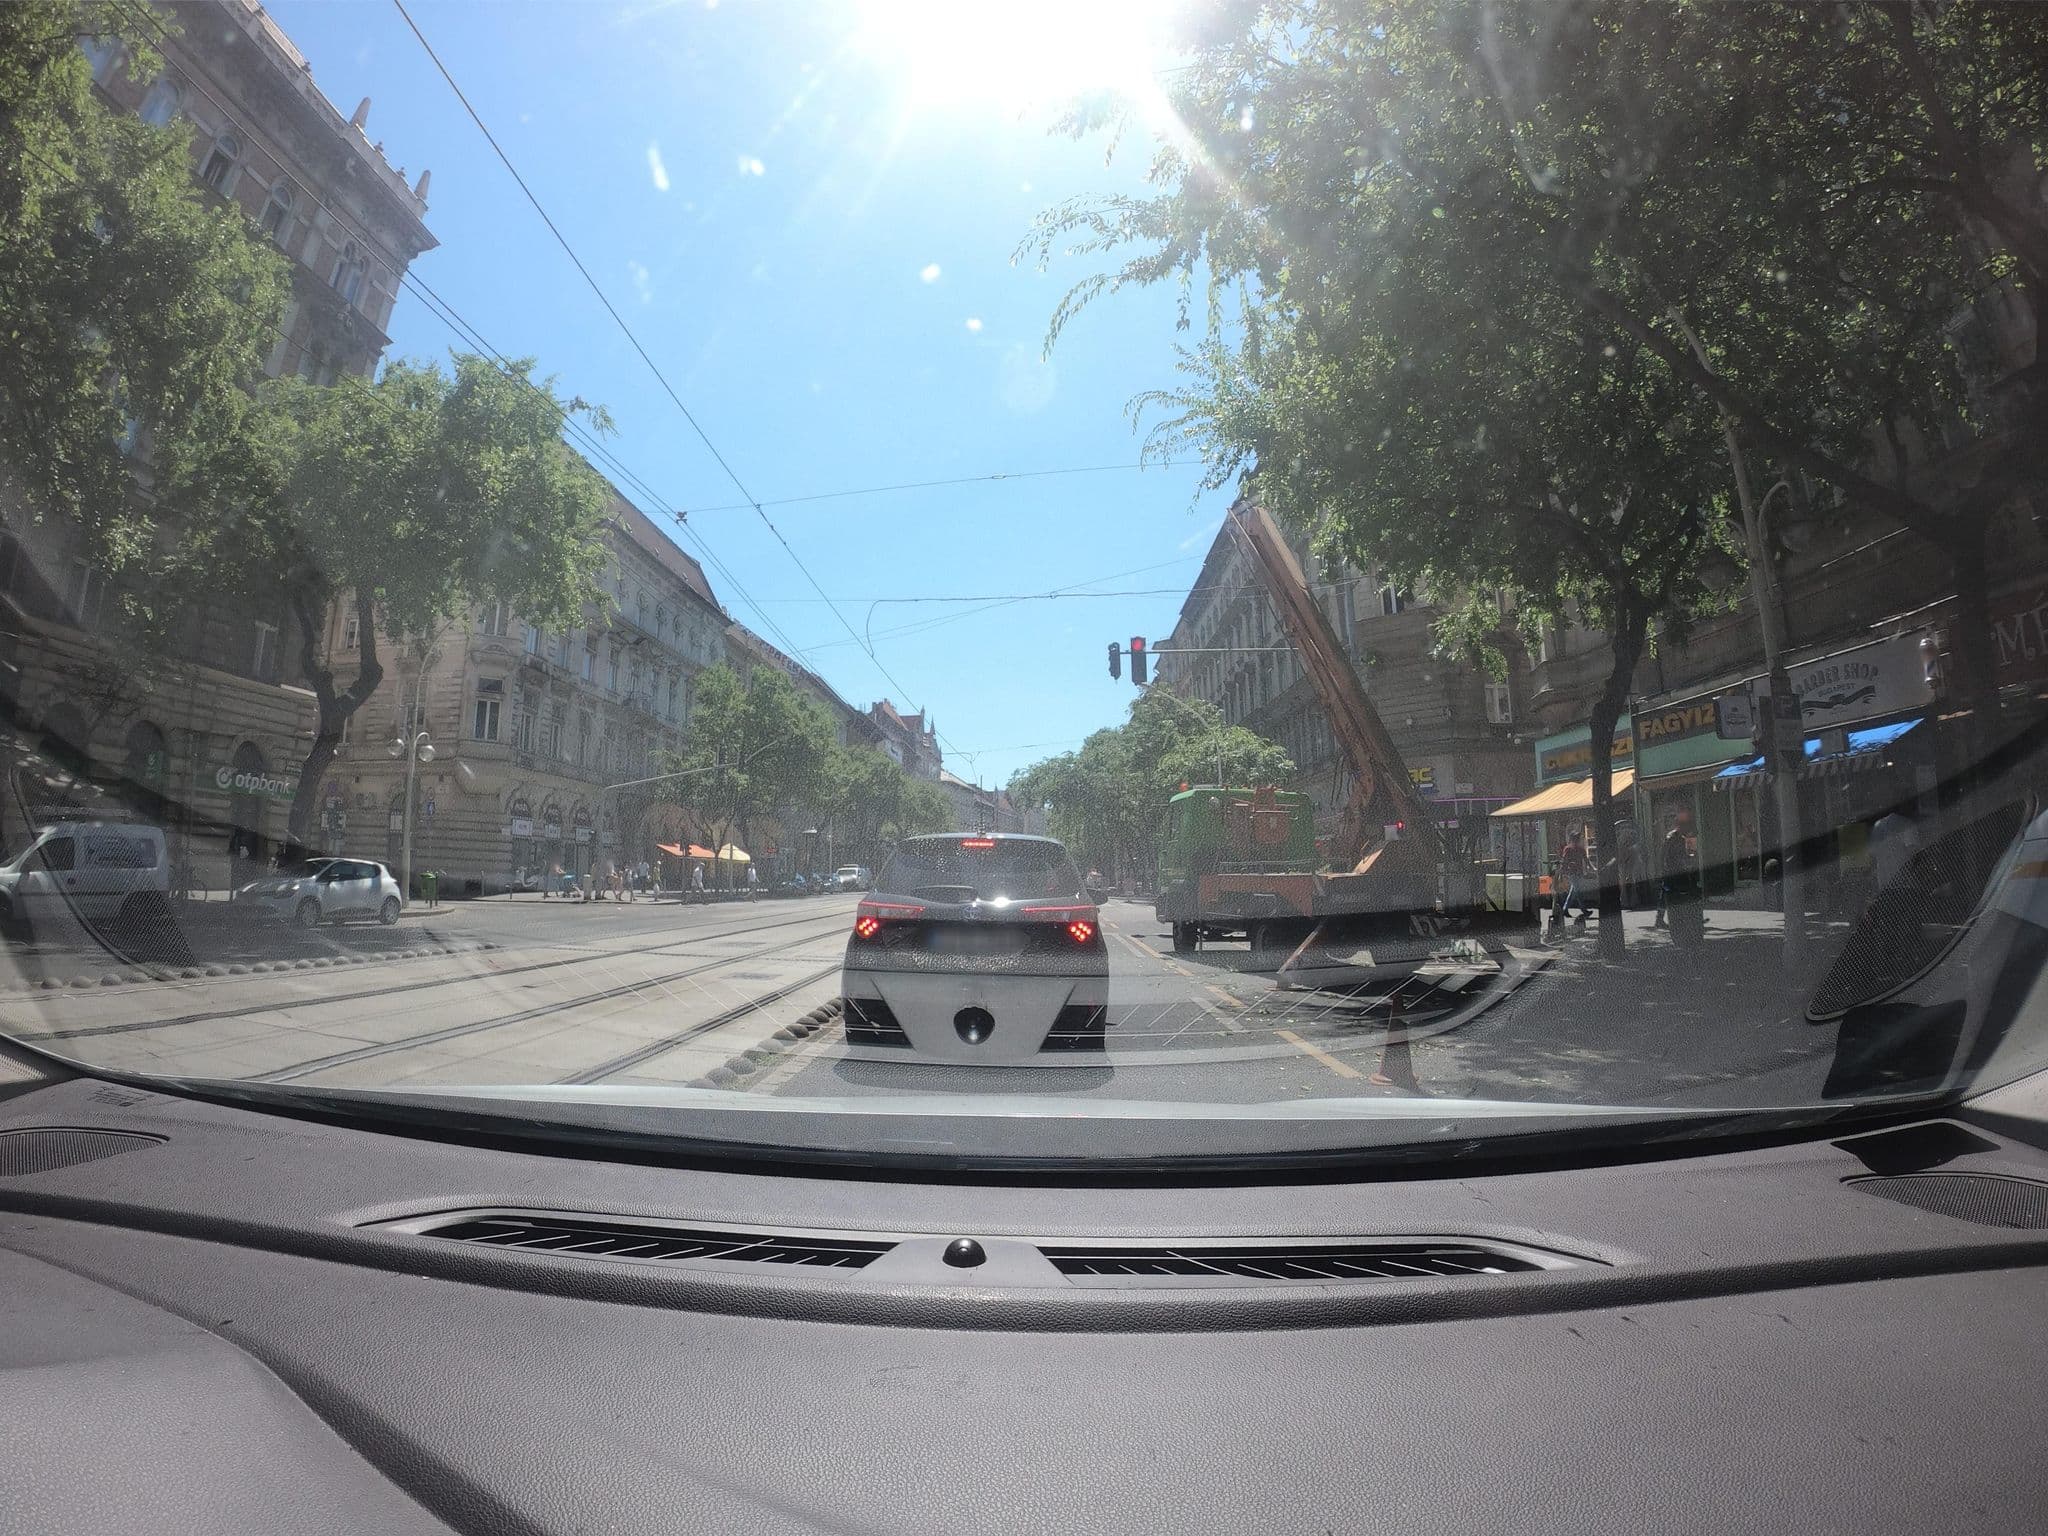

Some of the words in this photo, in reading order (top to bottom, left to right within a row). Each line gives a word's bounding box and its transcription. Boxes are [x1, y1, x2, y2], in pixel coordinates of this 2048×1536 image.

[1796, 666, 1839, 695] BARBER
[1844, 663, 1879, 681] SHOP
[1639, 703, 1715, 739] FAGYIZ
[235, 772, 290, 793] otpbank
